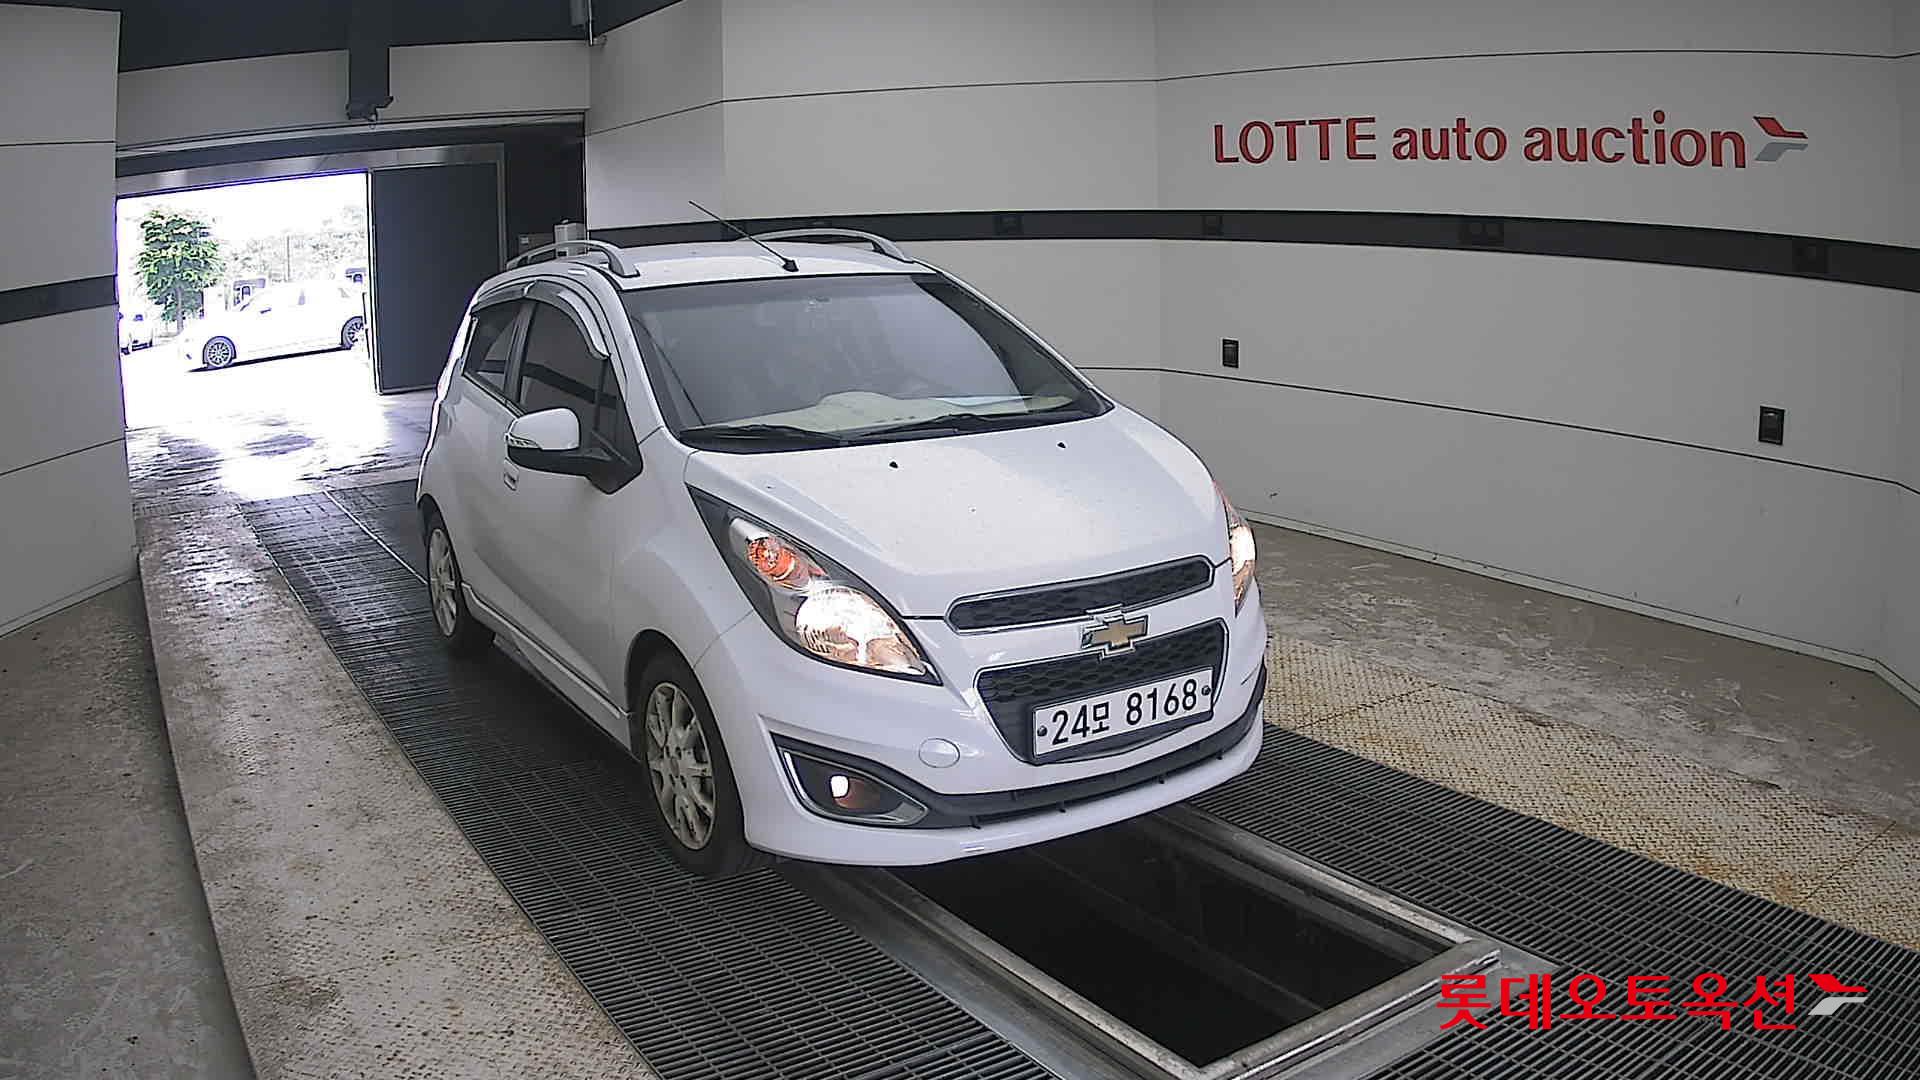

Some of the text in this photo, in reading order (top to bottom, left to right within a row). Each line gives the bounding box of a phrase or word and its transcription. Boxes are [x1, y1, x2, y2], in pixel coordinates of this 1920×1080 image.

[1214, 110, 1746, 168] LOTTE auto auction
[1052, 679, 1197, 745] 24모 8168
